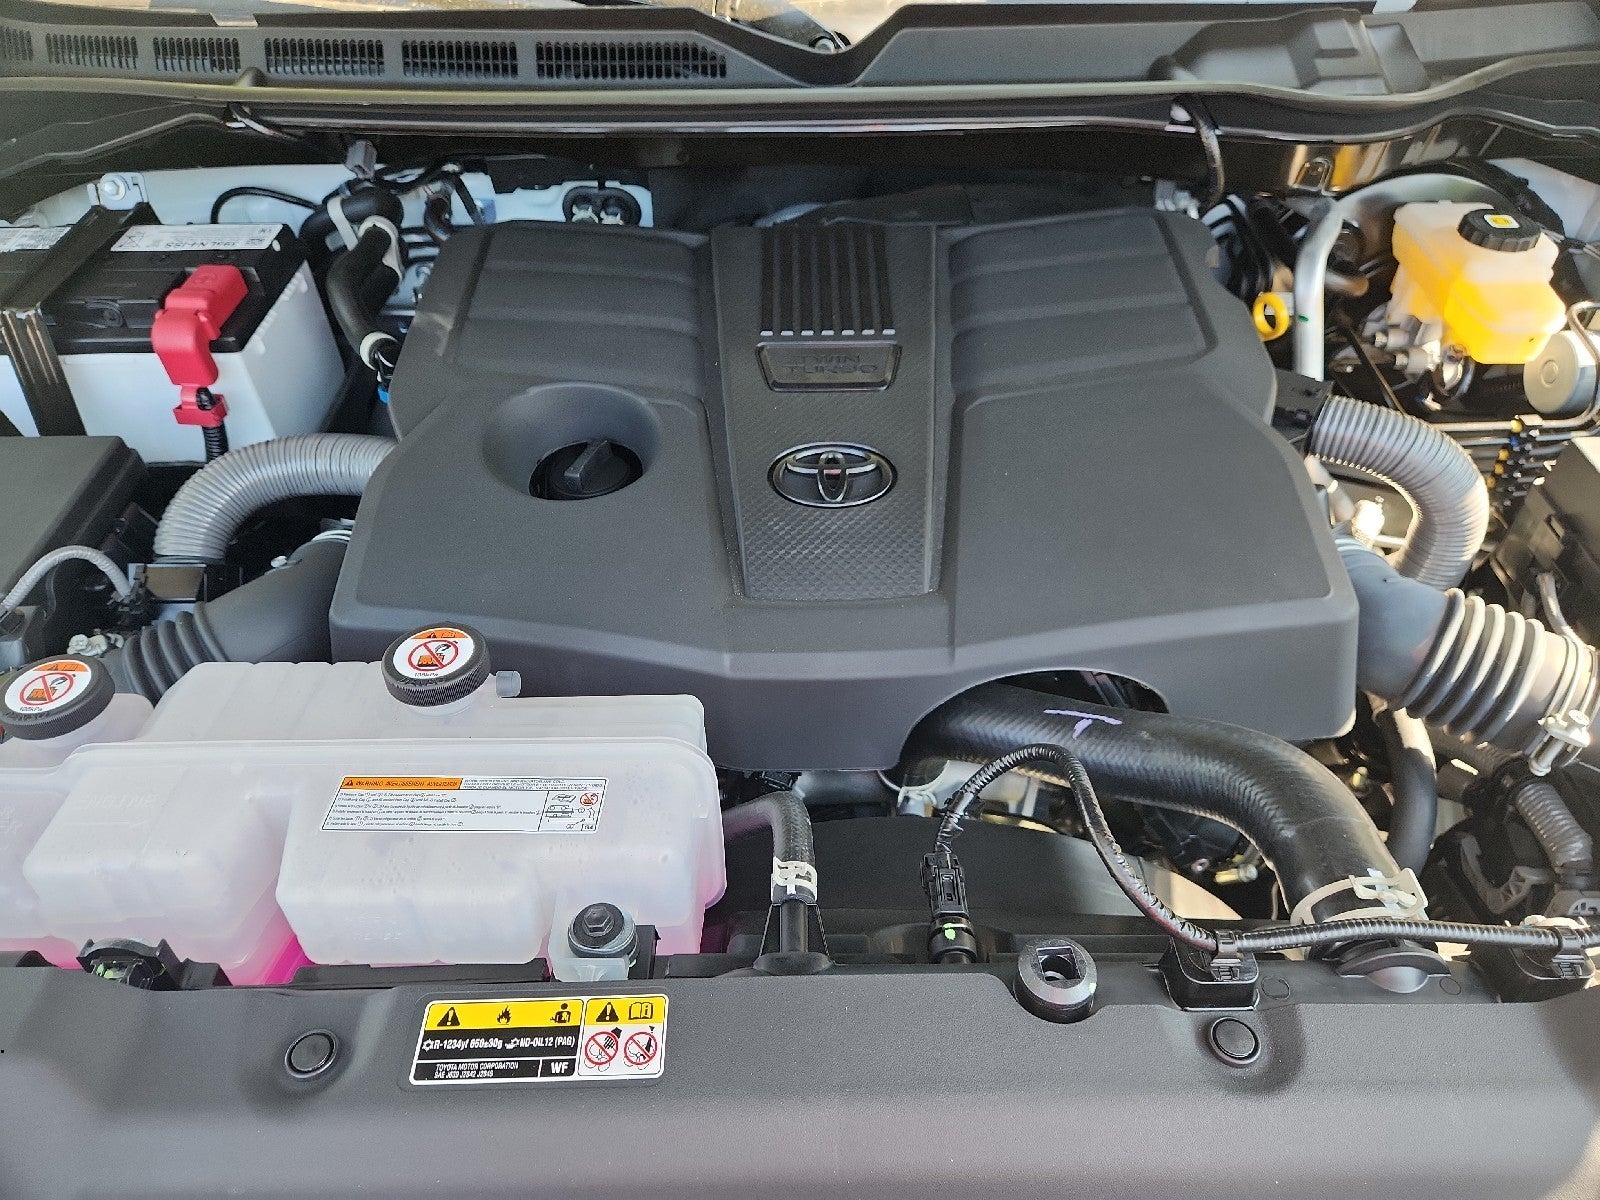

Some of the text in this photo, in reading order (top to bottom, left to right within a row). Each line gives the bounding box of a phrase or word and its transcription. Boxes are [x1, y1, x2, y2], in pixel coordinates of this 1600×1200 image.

[782, 364, 878, 374] TURBO
[434, 1038, 469, 1051] R-1234yf
[554, 1035, 576, 1048] (PAG)
[436, 1060, 519, 1072] TOYOTA MOTOR CORPORATION
[550, 1061, 569, 1074] WF
[433, 1071, 446, 1079] SAE
